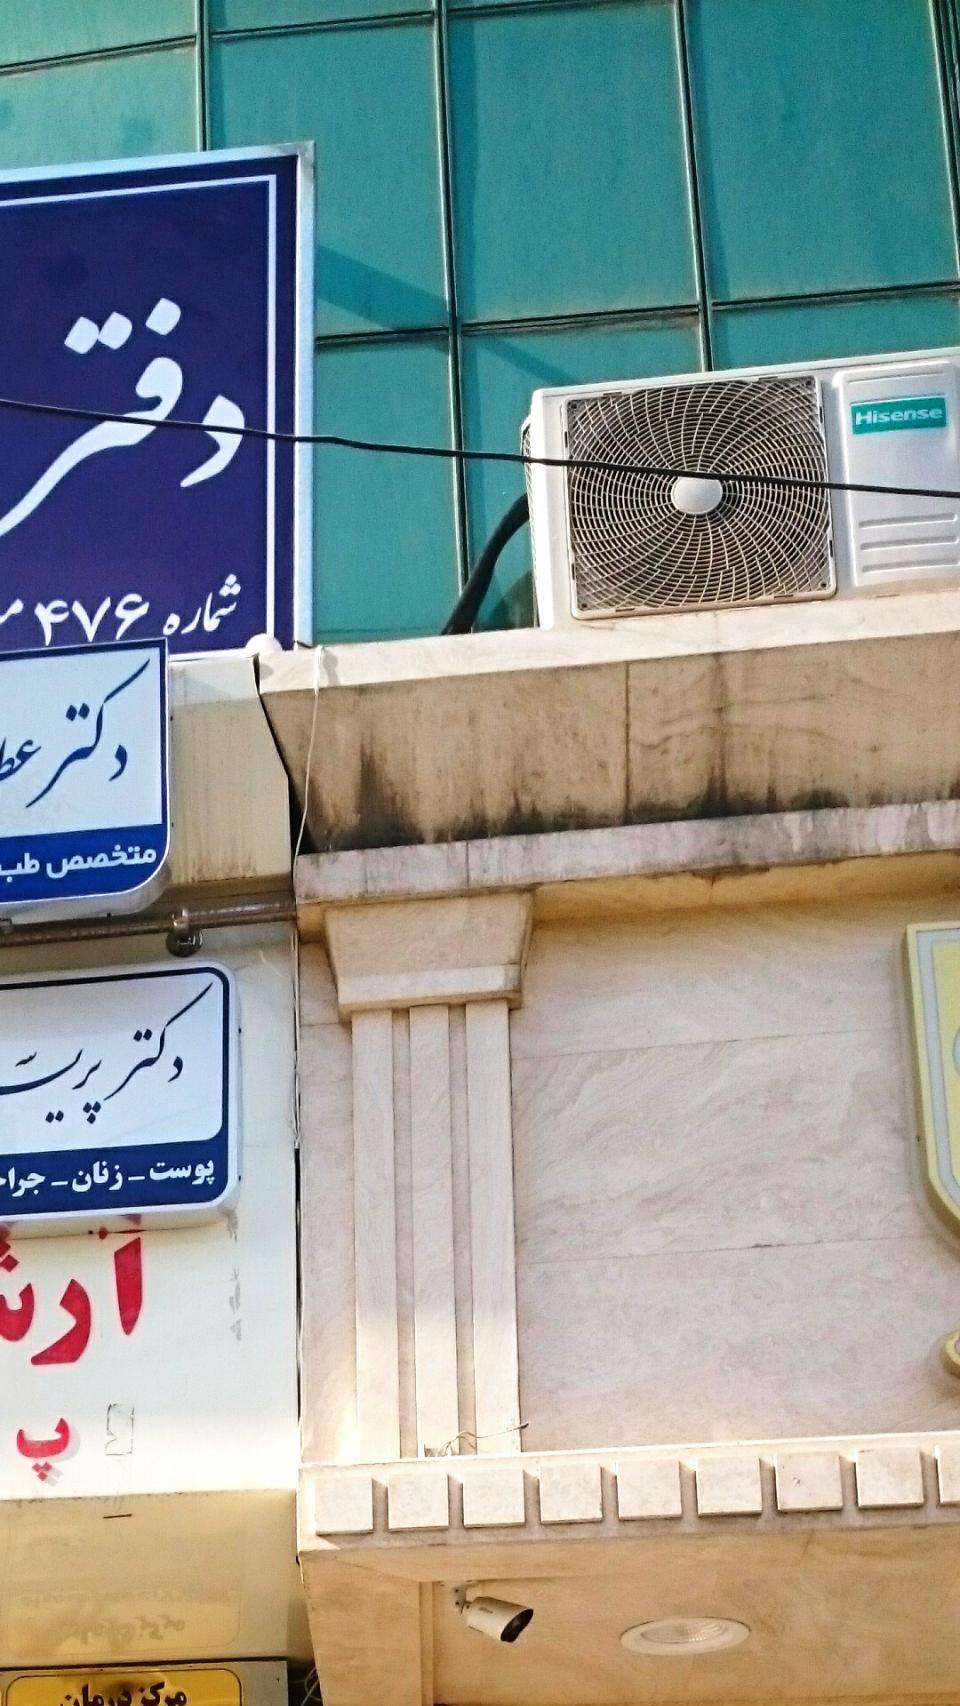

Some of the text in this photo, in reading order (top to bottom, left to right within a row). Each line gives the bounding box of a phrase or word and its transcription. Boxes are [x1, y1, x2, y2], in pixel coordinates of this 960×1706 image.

[855, 408, 943, 425] Hisense
[34, 593, 150, 647] ۴۷۶
[162, 573, 242, 636] شماره
[26, 659, 150, 808] دکتر
[46, 845, 157, 880] متخصص
[103, 982, 213, 1101] دکتر
[71, 1161, 124, 1192] زنان
[149, 1159, 215, 1186] پوست
